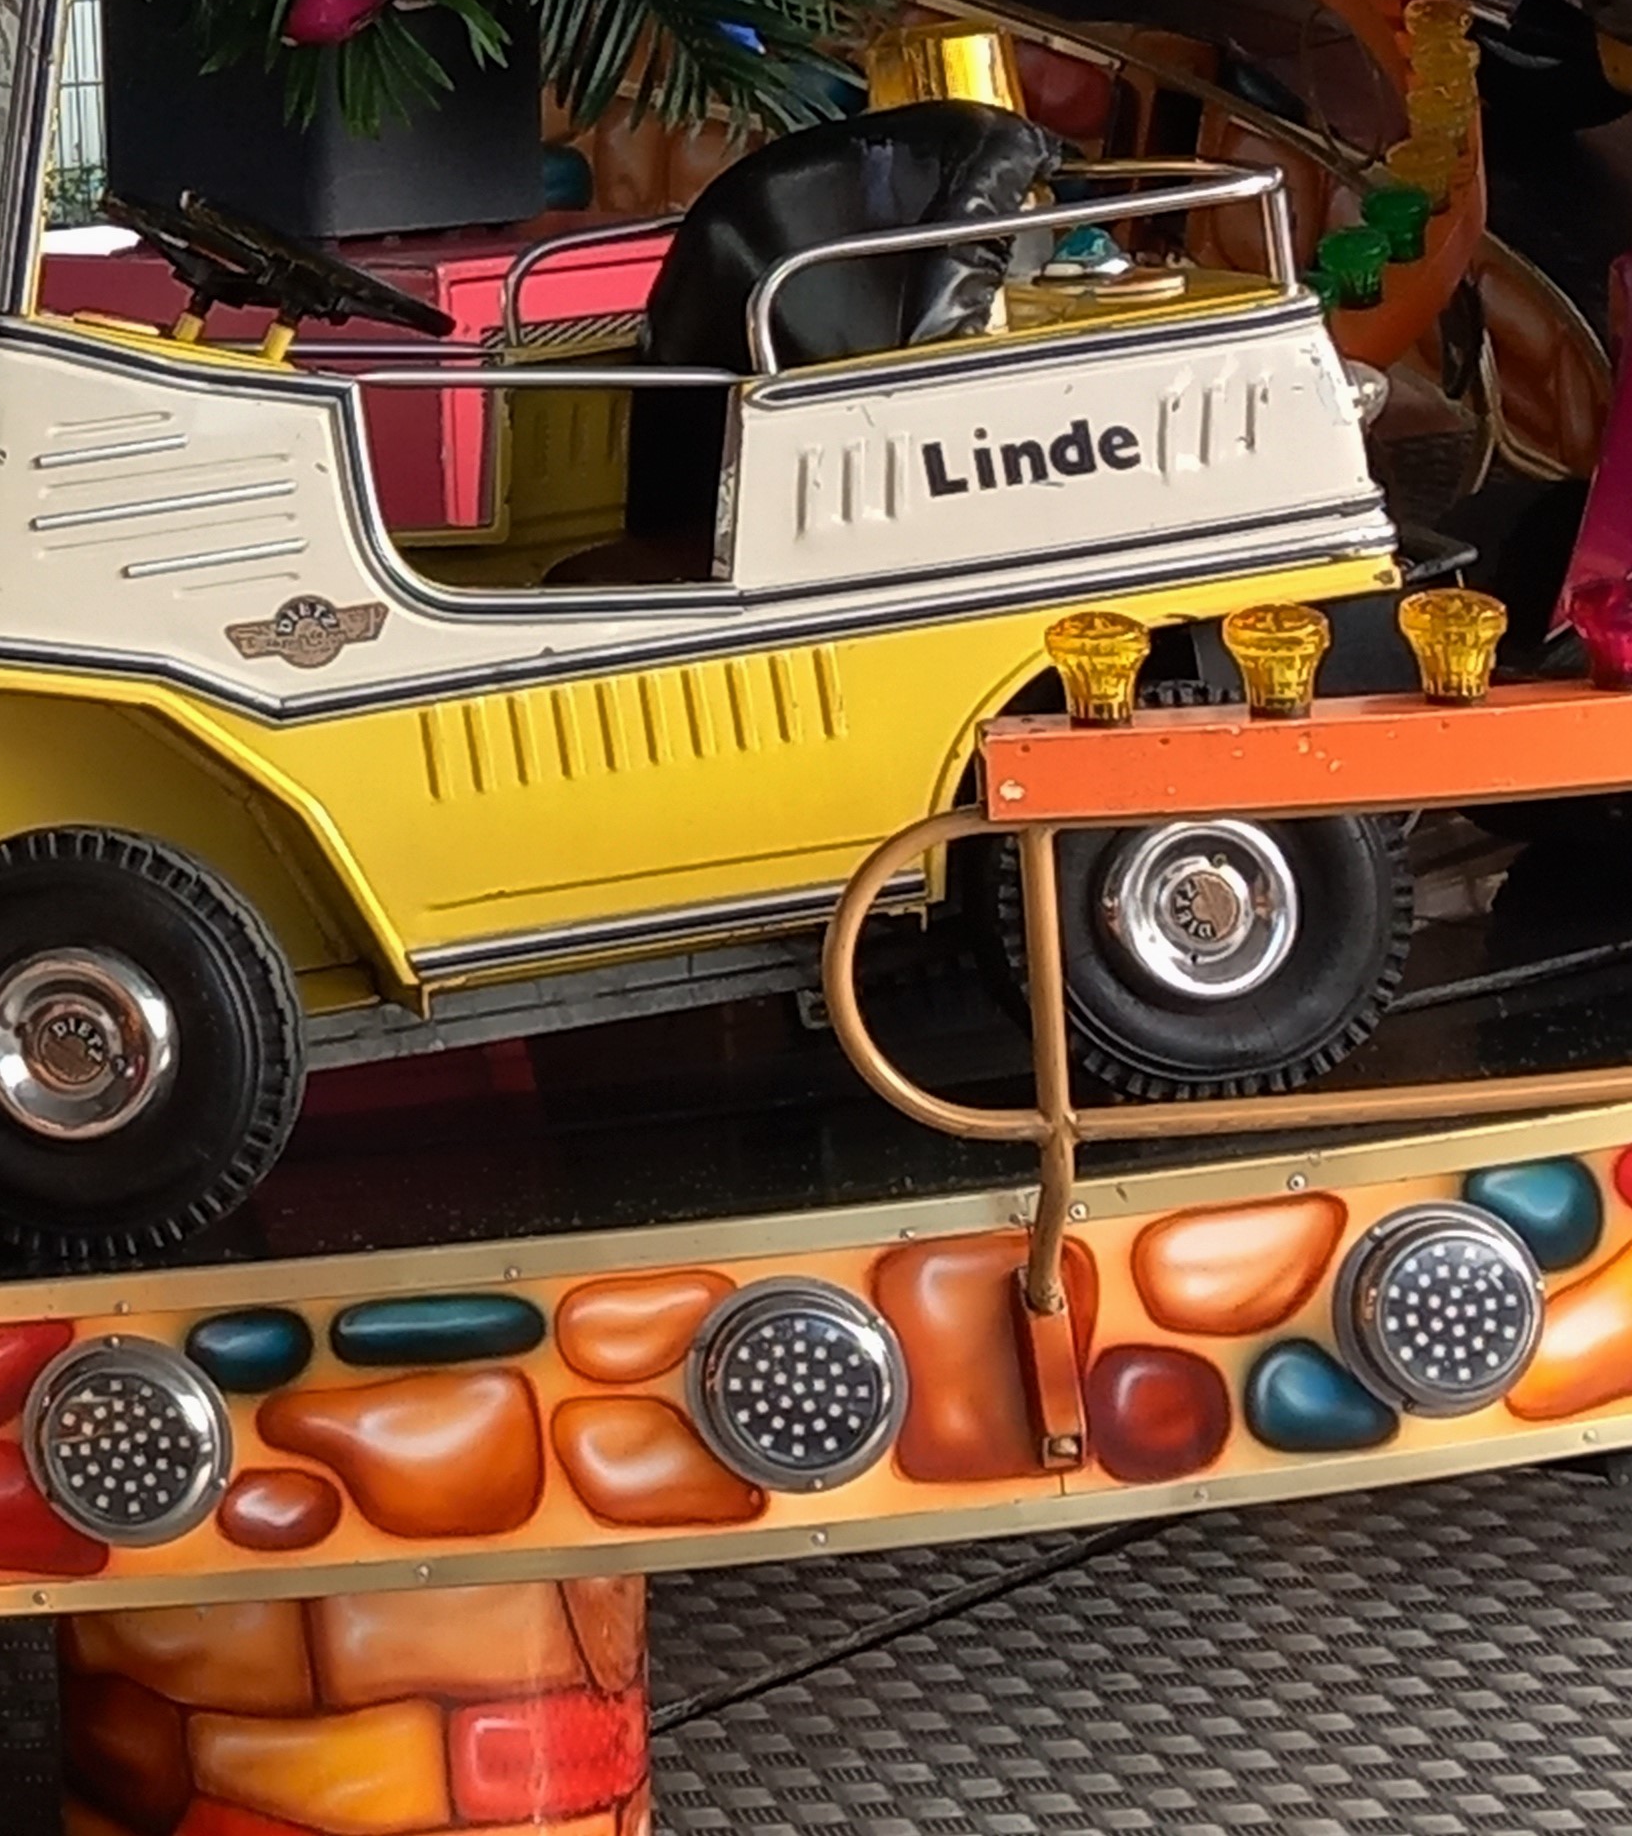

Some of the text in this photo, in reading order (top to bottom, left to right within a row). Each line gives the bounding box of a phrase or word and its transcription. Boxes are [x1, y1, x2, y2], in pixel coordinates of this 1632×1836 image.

[921, 418, 1142, 498] Linde
[277, 603, 338, 634] DIETZ
[1174, 877, 1213, 939] DIETZ
[51, 1017, 104, 1063] DIETZ
